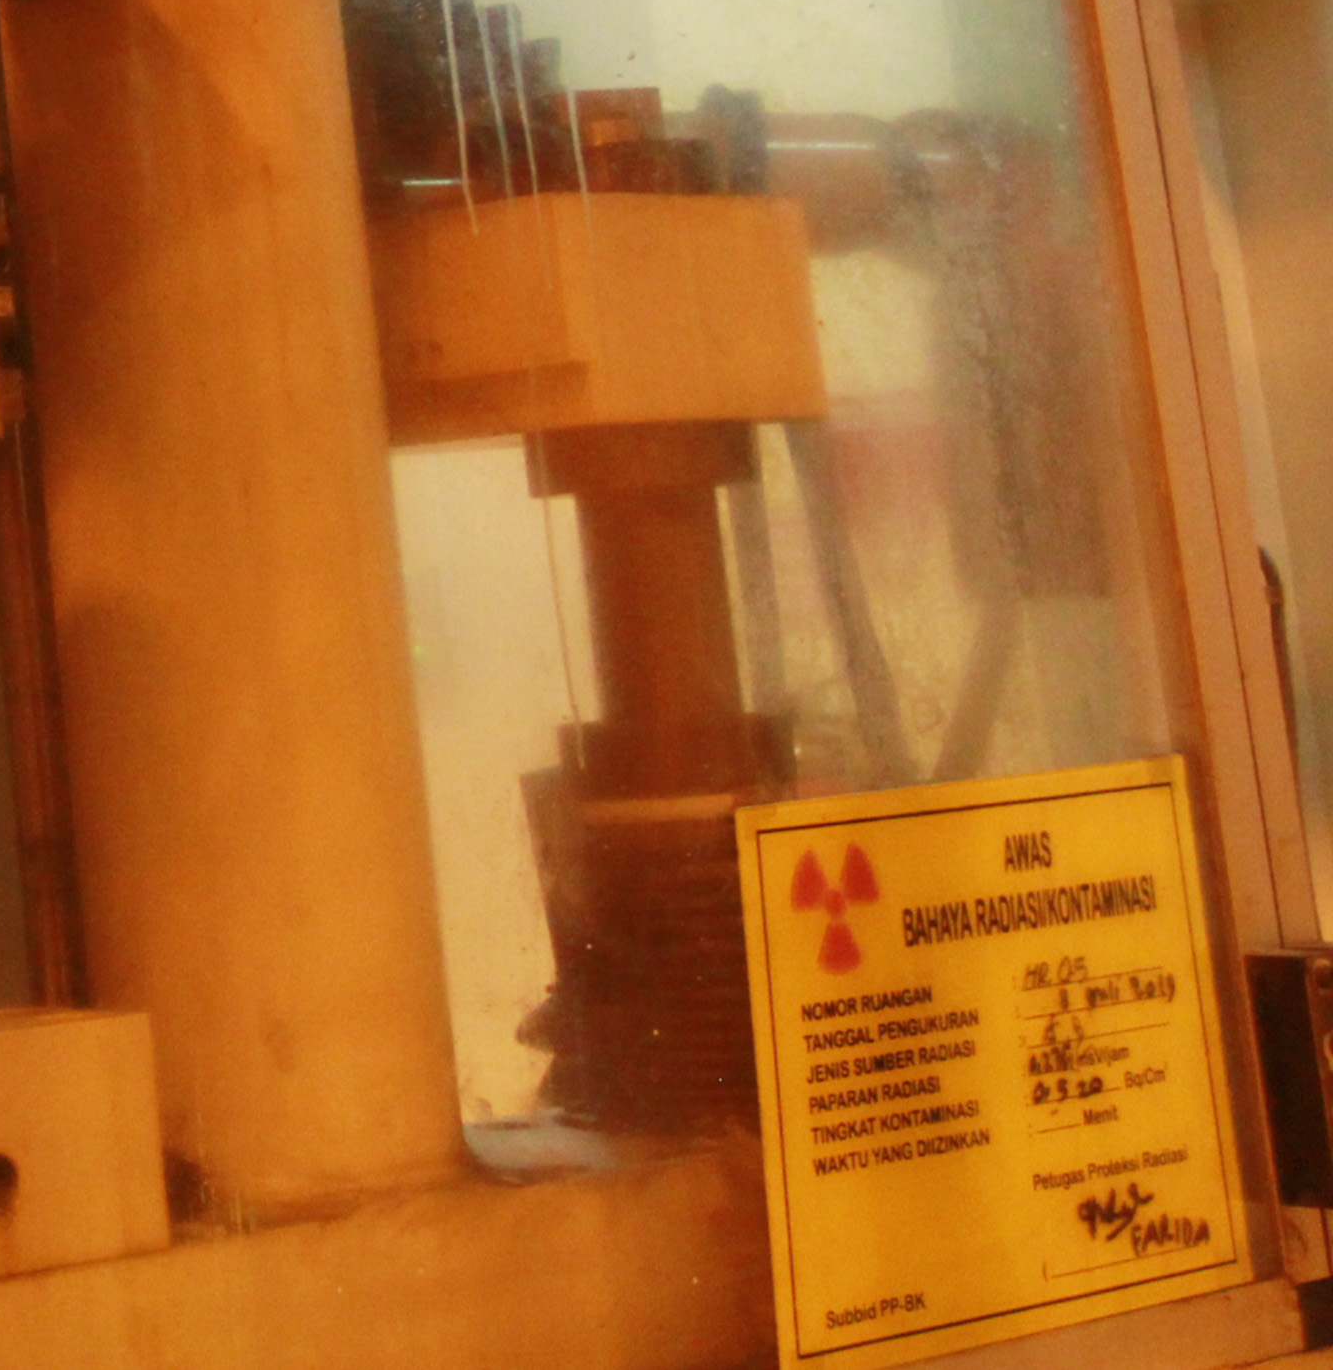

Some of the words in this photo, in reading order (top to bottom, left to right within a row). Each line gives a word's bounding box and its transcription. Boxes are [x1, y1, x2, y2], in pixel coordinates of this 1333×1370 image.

[1004, 831, 1052, 873] AWAS
[902, 901, 973, 947] BAHAYA
[801, 997, 858, 1022] NOMOR
[861, 986, 933, 1012] RUANGAN
[803, 1027, 874, 1053] TANGGAL
[878, 1009, 979, 1041] PENGUKURAN
[807, 1060, 850, 1084] JENIS
[853, 1050, 915, 1076] SUMBER
[919, 1040, 976, 1065] RADIASI
[809, 1087, 878, 1114] PAPARAN
[882, 1076, 941, 1101] RADIASI
[1083, 1104, 1118, 1125] Menit
[811, 1117, 876, 1145] TINGKAT
[880, 1100, 979, 1133] KONTAMINASI
[813, 1150, 869, 1176] WAKTU
[872, 1143, 913, 1165] YANG
[1033, 1169, 1085, 1190] Petugas
[1087, 1159, 1140, 1179] Proteksi
[1142, 1145, 1188, 1168] Radiasi
[826, 1301, 877, 1329] Subbid
[880, 1292, 926, 1317] PP-BK
